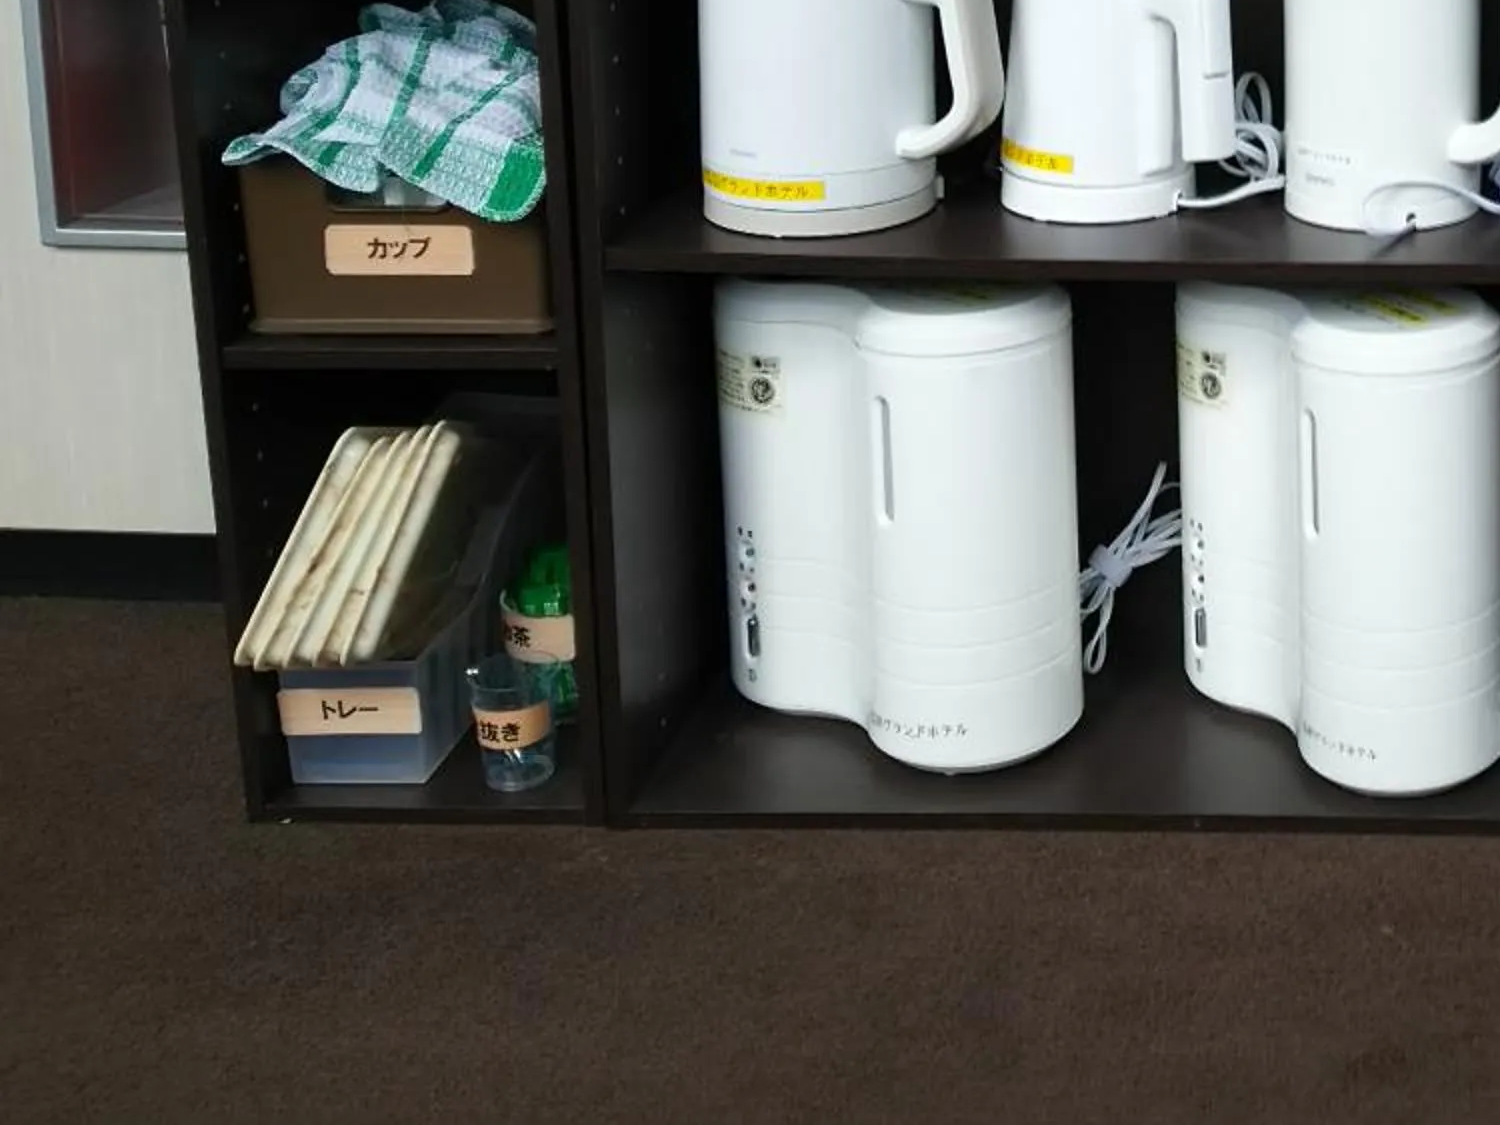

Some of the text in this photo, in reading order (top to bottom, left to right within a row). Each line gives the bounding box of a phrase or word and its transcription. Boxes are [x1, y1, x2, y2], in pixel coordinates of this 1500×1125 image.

[367, 236, 431, 259] カップ
[321, 699, 379, 721] トレー
